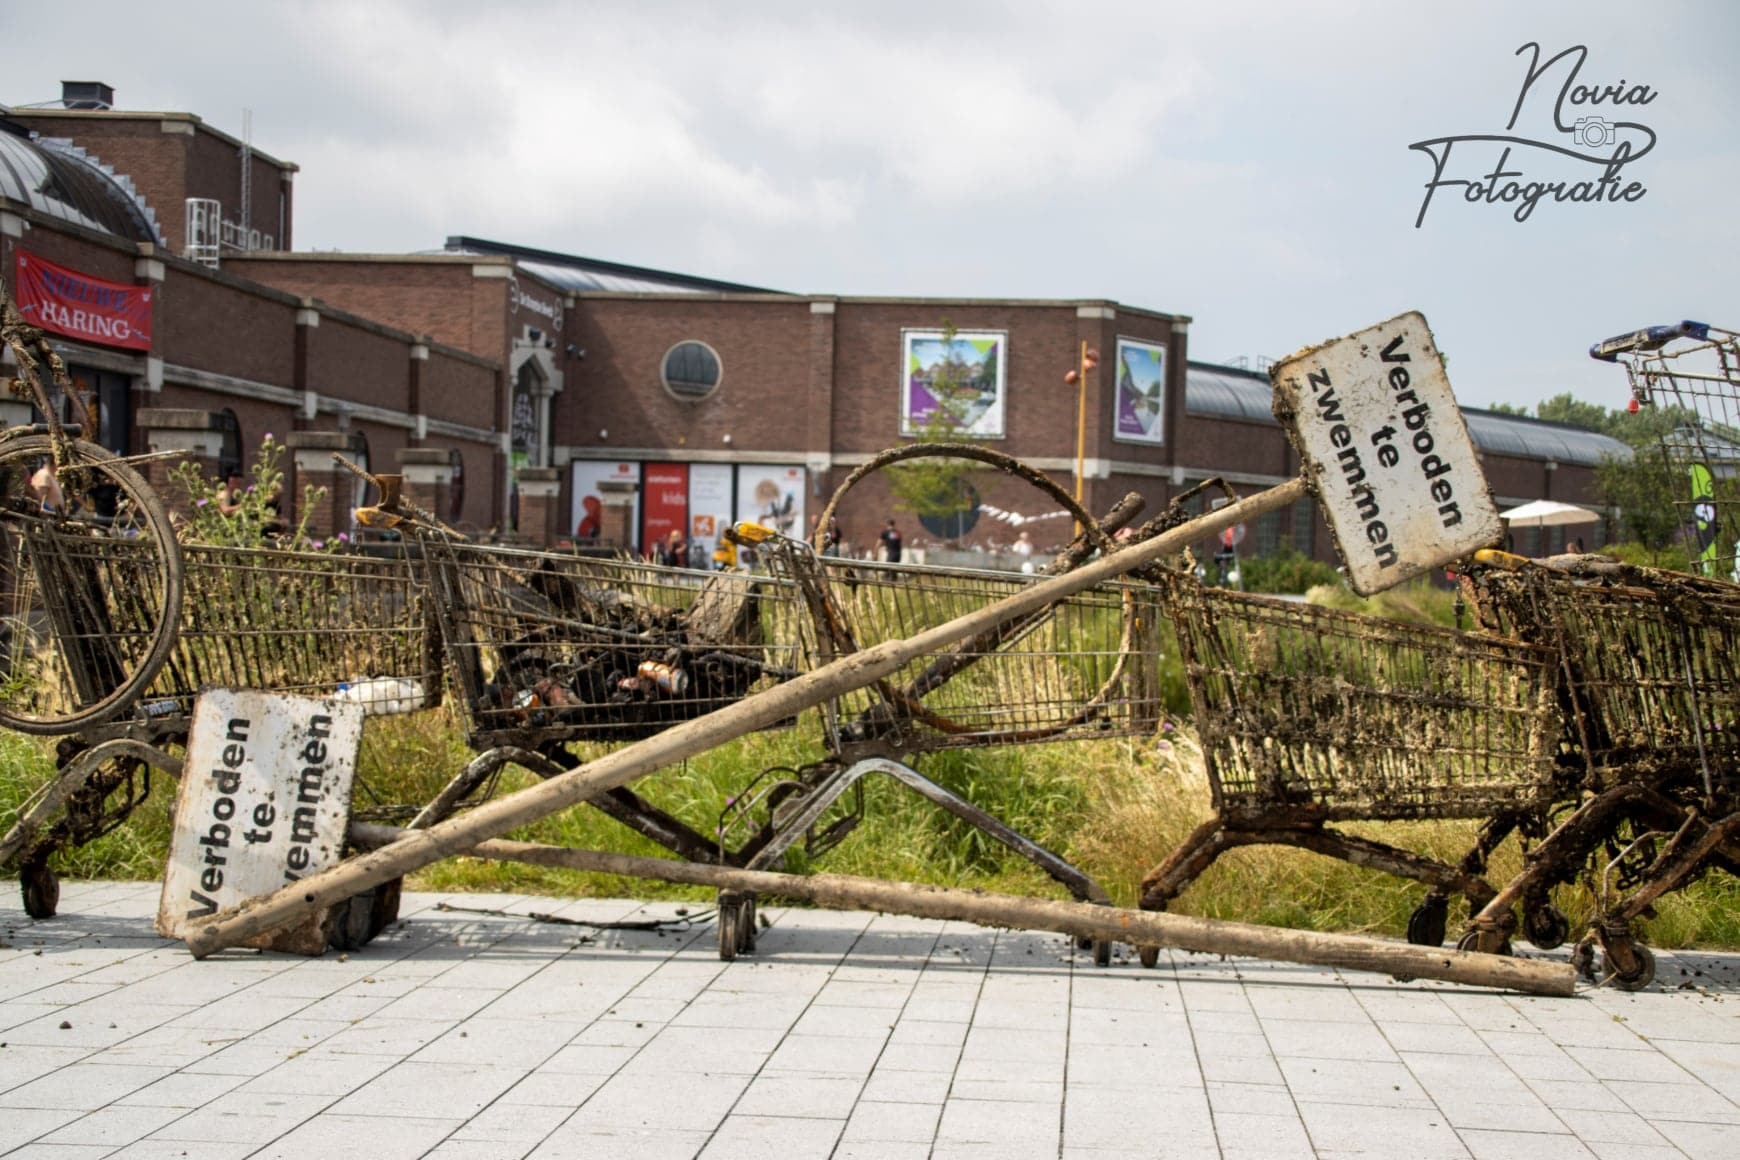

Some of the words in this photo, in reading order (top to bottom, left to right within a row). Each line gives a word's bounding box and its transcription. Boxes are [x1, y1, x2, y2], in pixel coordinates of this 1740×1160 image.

[41, 268, 129, 312] NIEUWE
[41, 300, 131, 339] HARING
[1307, 367, 1399, 569] zwemmen
[1371, 425, 1400, 469] te
[1379, 334, 1463, 528] Verboden
[187, 718, 250, 920] Verboden
[243, 802, 276, 845] te
[282, 714, 333, 888] emmen
